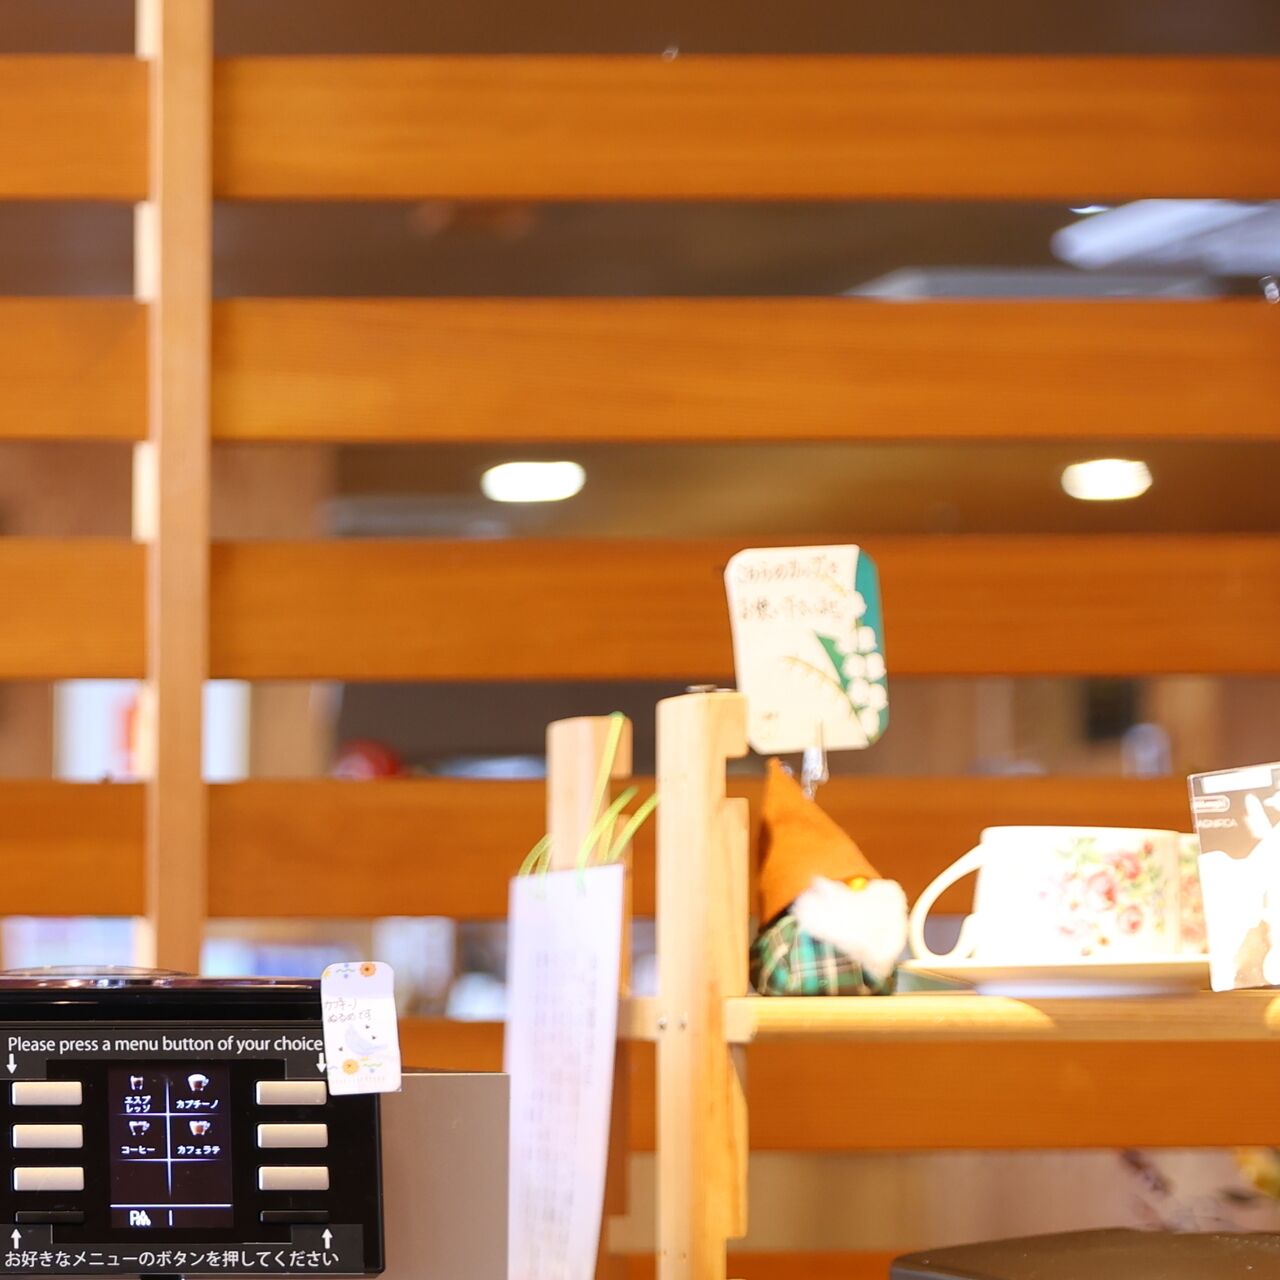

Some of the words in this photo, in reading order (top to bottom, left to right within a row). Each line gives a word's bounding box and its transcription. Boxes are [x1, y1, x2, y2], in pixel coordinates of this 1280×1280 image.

[7, 1036, 56, 1052] Please
[59, 1039, 99, 1055] press
[101, 1039, 111, 1051] a
[114, 1039, 159, 1051] menu
[162, 1035, 214, 1051] button
[217, 1035, 234, 1051] of
[236, 1039, 271, 1055] your
[274, 1035, 324, 1051] choice
[176, 1099, 219, 1109] カプチーノ
[121, 1145, 156, 1155] コーヒー
[177, 1145, 221, 1155] カフェラテ
[4, 1250, 340, 1268] お好きなメニューのボタンを押してください
